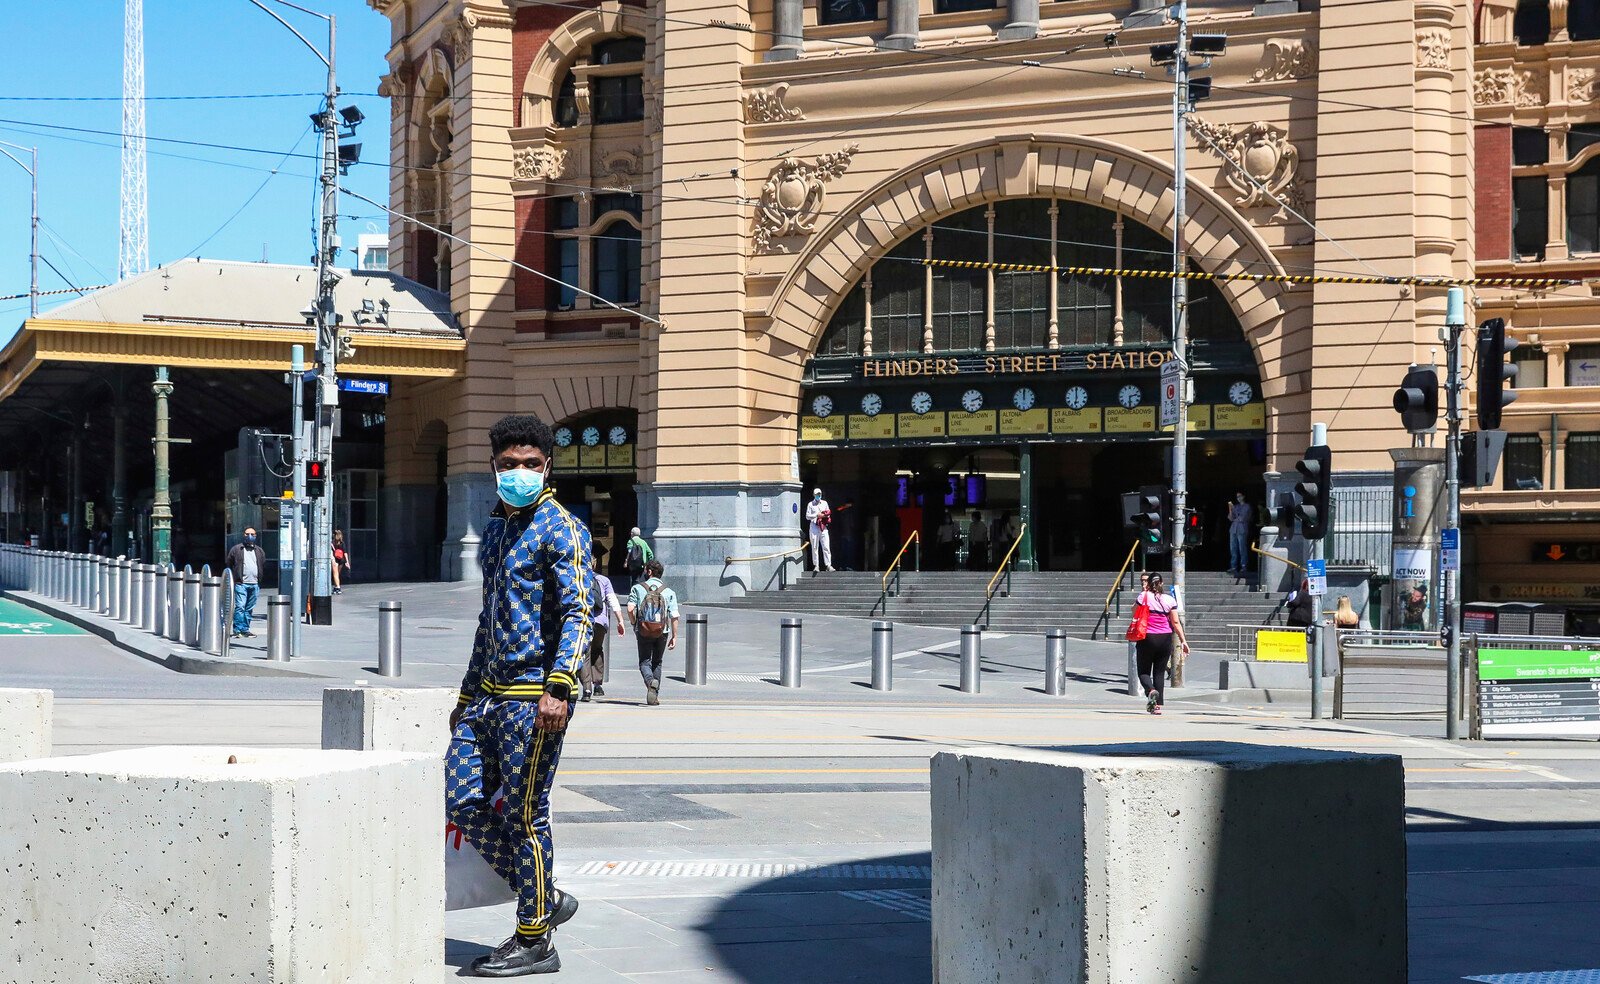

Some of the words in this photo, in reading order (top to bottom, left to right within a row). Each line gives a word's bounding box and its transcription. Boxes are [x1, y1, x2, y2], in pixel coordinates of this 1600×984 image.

[863, 358, 959, 377] FLINDERS
[985, 354, 1061, 373] STREET
[351, 380, 377, 389] Flinders
[378, 382, 386, 390] St
[1516, 667, 1547, 676] Swanston
[1548, 667, 1556, 675] St
[1556, 667, 1569, 675] and
[1570, 666, 1594, 675] Flinders
